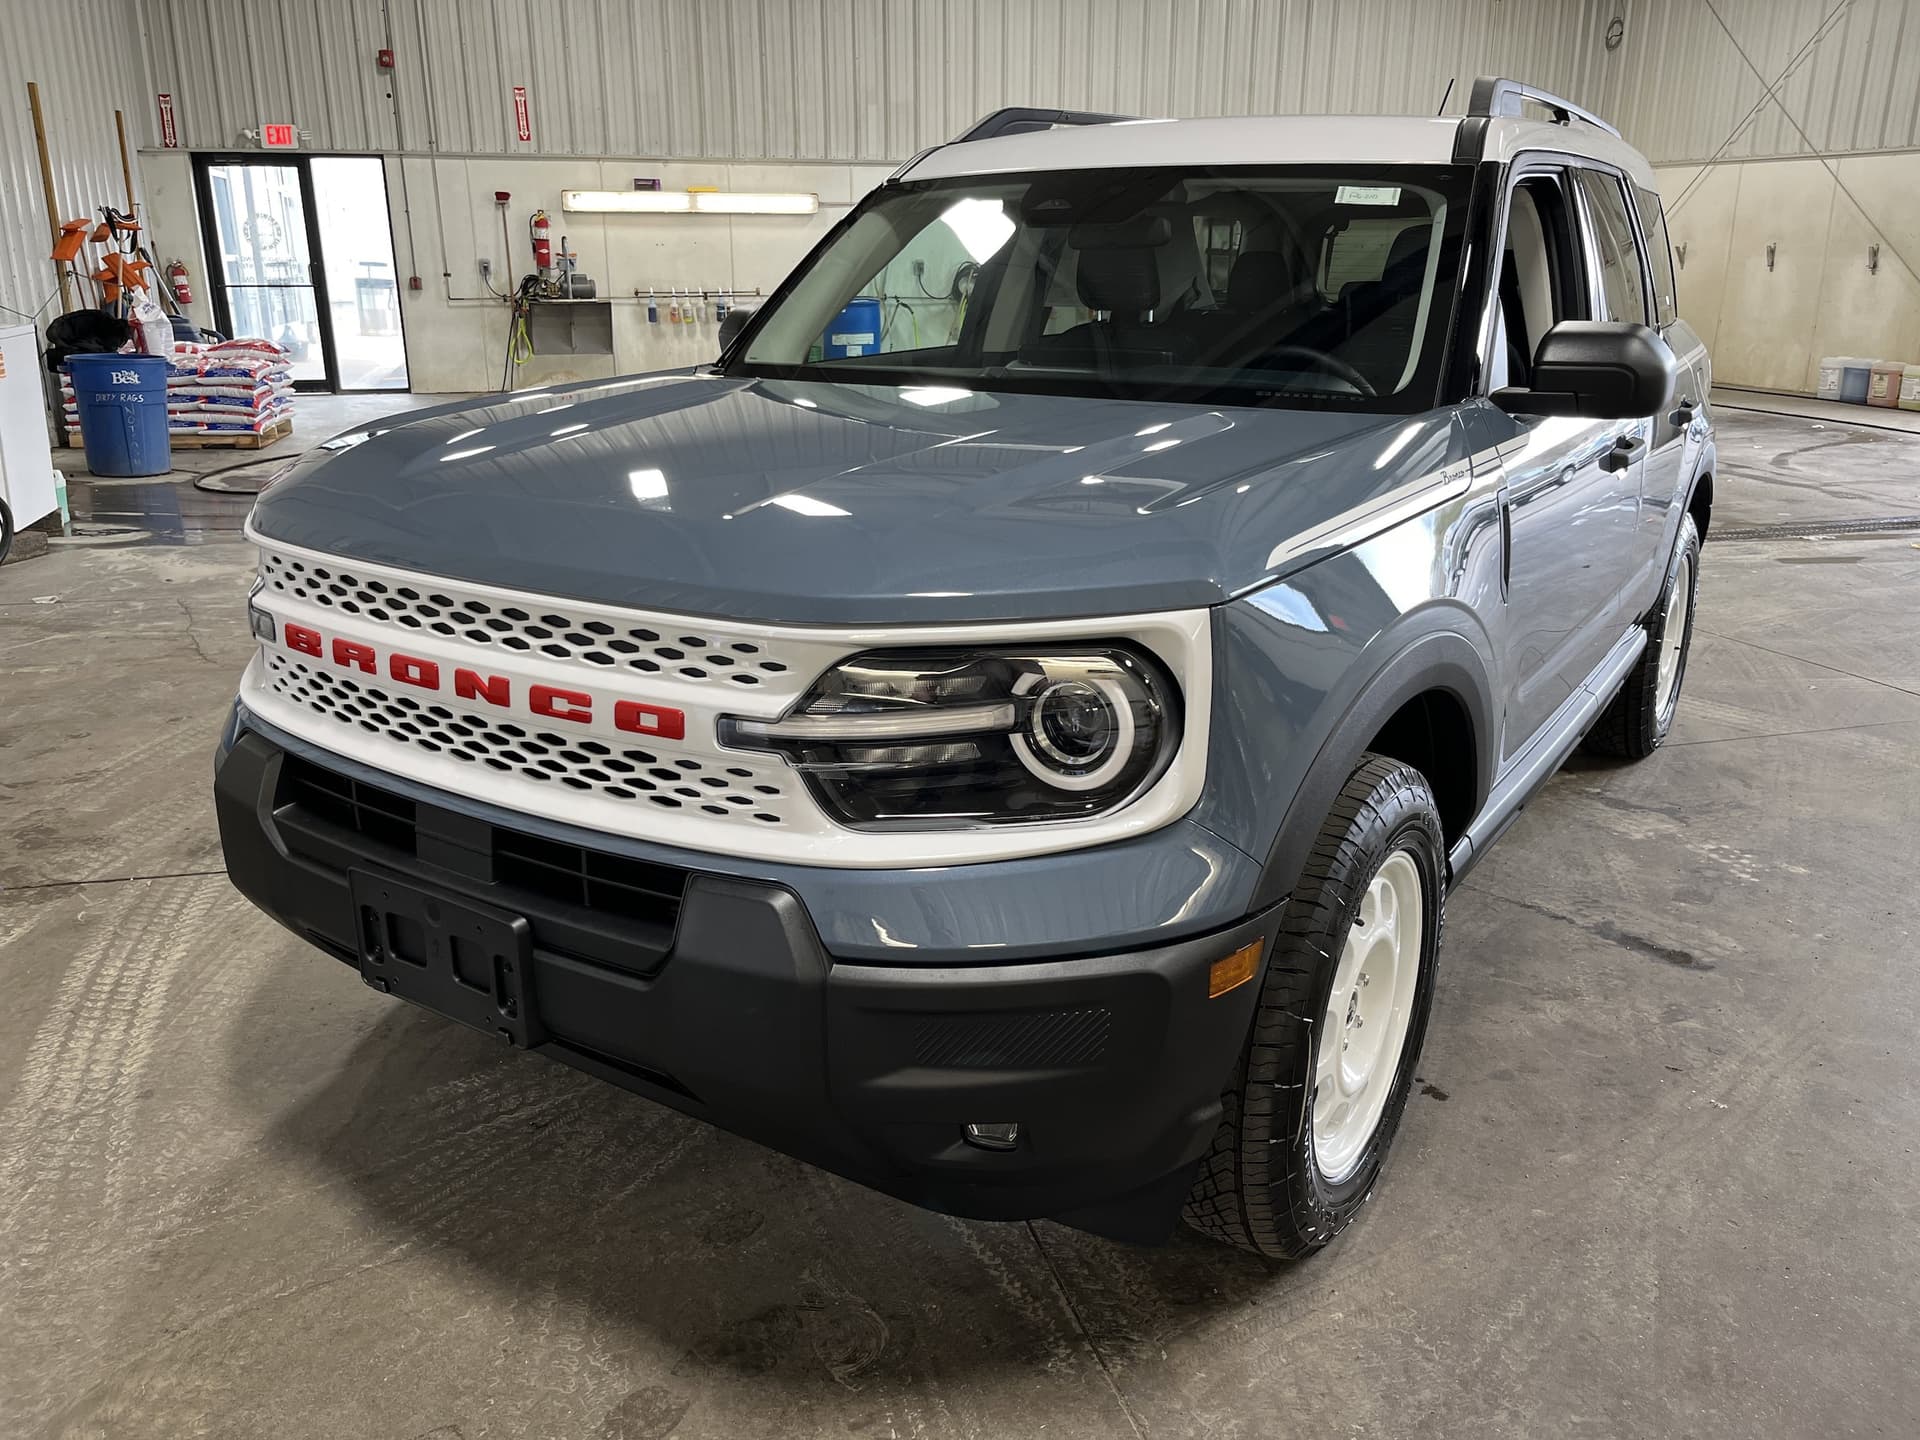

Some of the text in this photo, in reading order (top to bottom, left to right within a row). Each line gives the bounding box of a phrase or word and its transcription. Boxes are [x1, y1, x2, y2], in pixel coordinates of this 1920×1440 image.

[266, 125, 292, 145] EXIT
[111, 371, 142, 384] Best
[120, 393, 144, 402] RAGS
[284, 622, 685, 740] BRONCO
